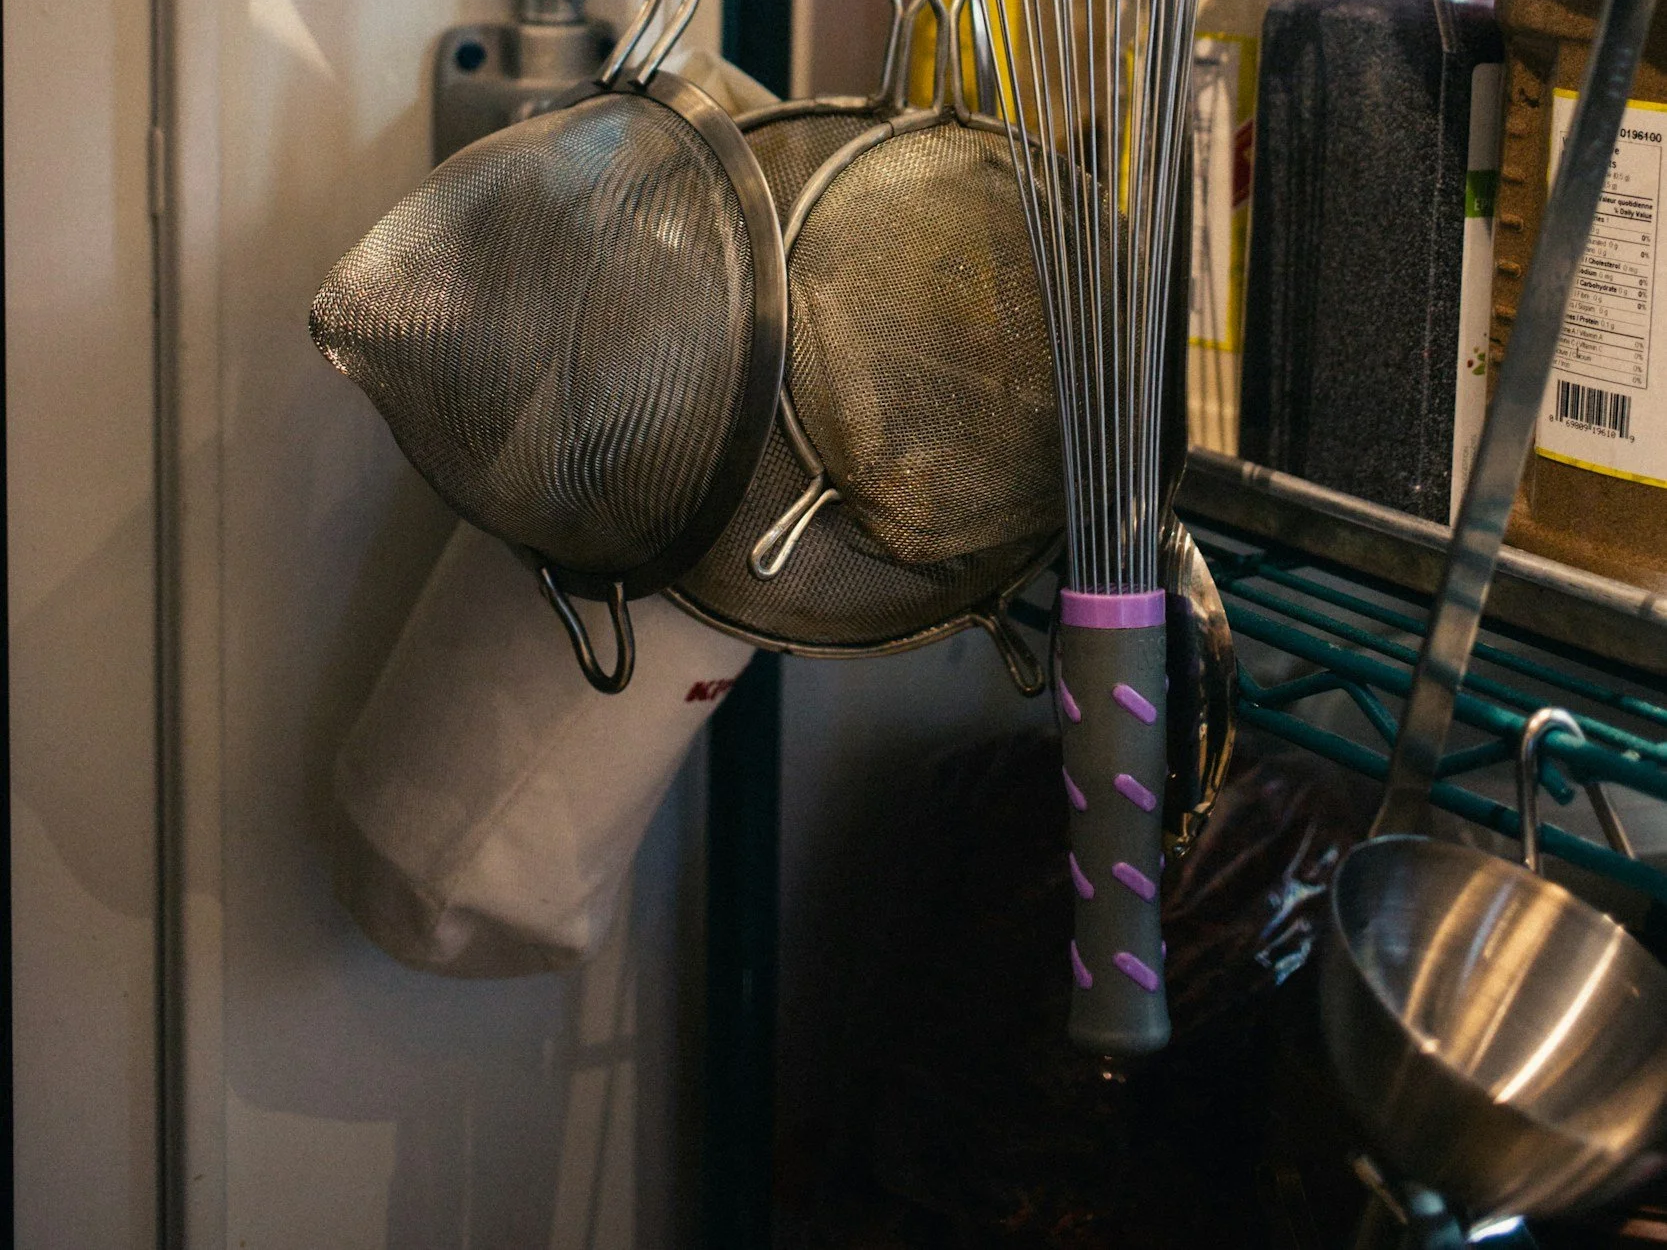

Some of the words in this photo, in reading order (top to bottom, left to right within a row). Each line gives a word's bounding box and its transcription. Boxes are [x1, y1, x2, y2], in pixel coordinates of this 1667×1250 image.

[1588, 257, 1620, 269] Cholesterol
[1580, 279, 1617, 293] Carbohydrate
[1580, 316, 1599, 325] Protein
